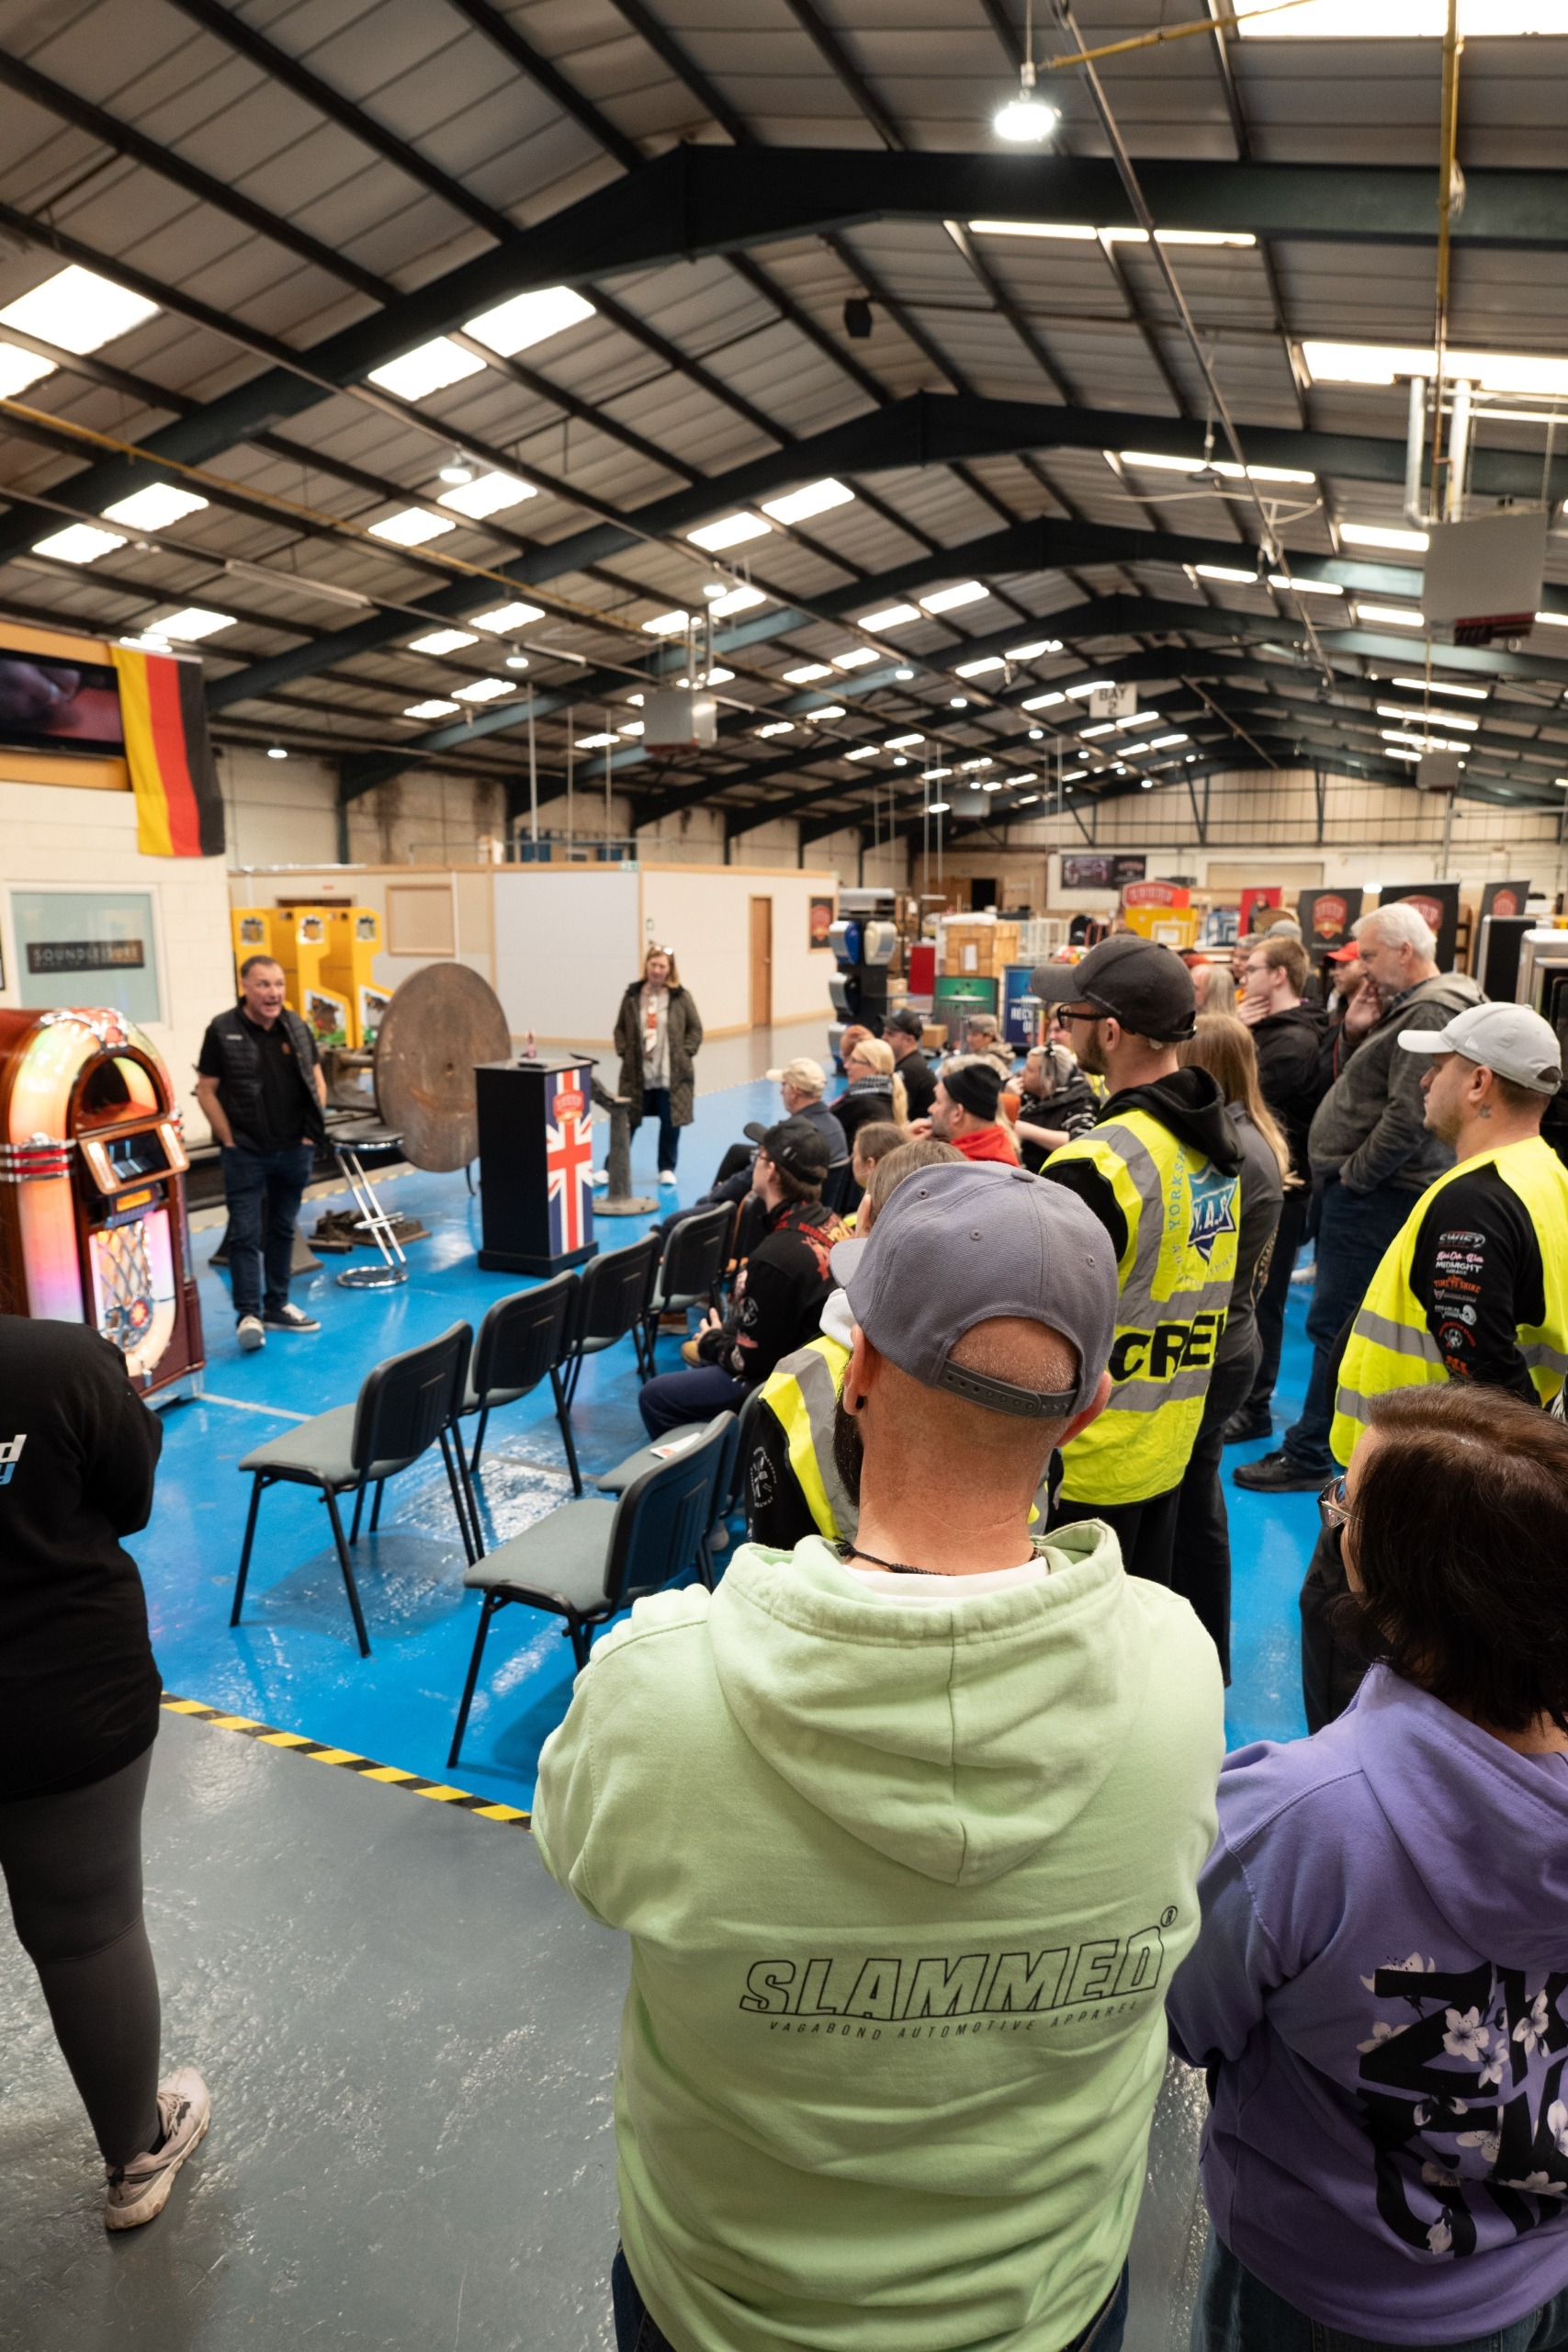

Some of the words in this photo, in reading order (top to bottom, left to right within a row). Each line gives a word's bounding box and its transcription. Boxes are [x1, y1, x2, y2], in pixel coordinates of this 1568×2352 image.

[1100, 687, 1126, 700] BAY
[1107, 701, 1118, 716] 2
[1168, 1145, 1188, 1231] YORKSH
[1435, 1261, 1483, 1273] MIDNIGHT
[770, 2020, 882, 2041] VAGABOND
[897, 2018, 1034, 2039] AUTOMOTIVE
[1050, 2000, 1137, 2029] APPAREL
